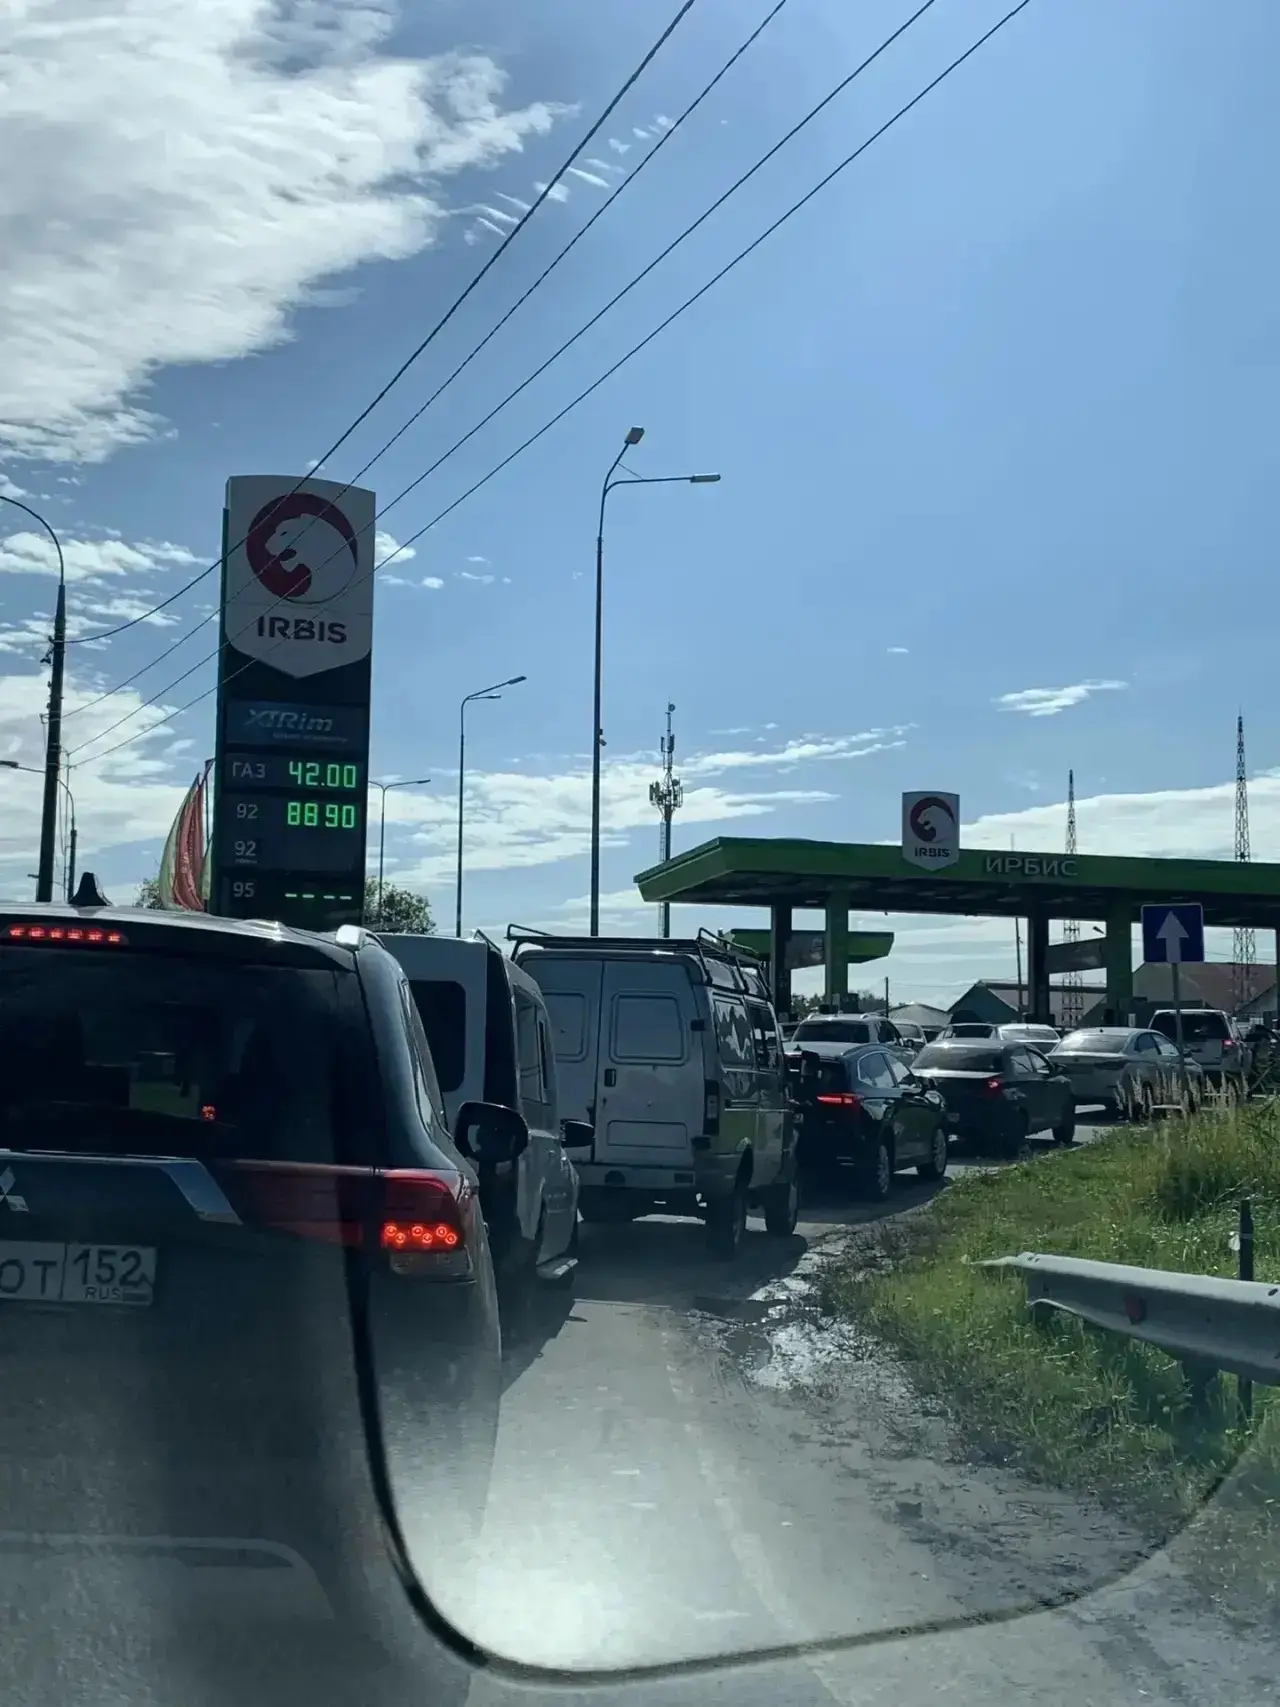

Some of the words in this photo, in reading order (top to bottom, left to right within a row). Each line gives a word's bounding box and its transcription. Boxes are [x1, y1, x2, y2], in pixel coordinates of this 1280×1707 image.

[257, 616, 347, 643] IRBIS
[232, 762, 266, 778] ГАЗ
[289, 761, 356, 788] 42.00
[236, 803, 258, 819] 92
[234, 840, 257, 856] 92
[914, 847, 950, 858] IRBIS
[985, 856, 1078, 876] ИРБИС
[233, 881, 255, 898] 95
[73, 1248, 142, 1287] 152
[85, 1286, 121, 1300] RUS
